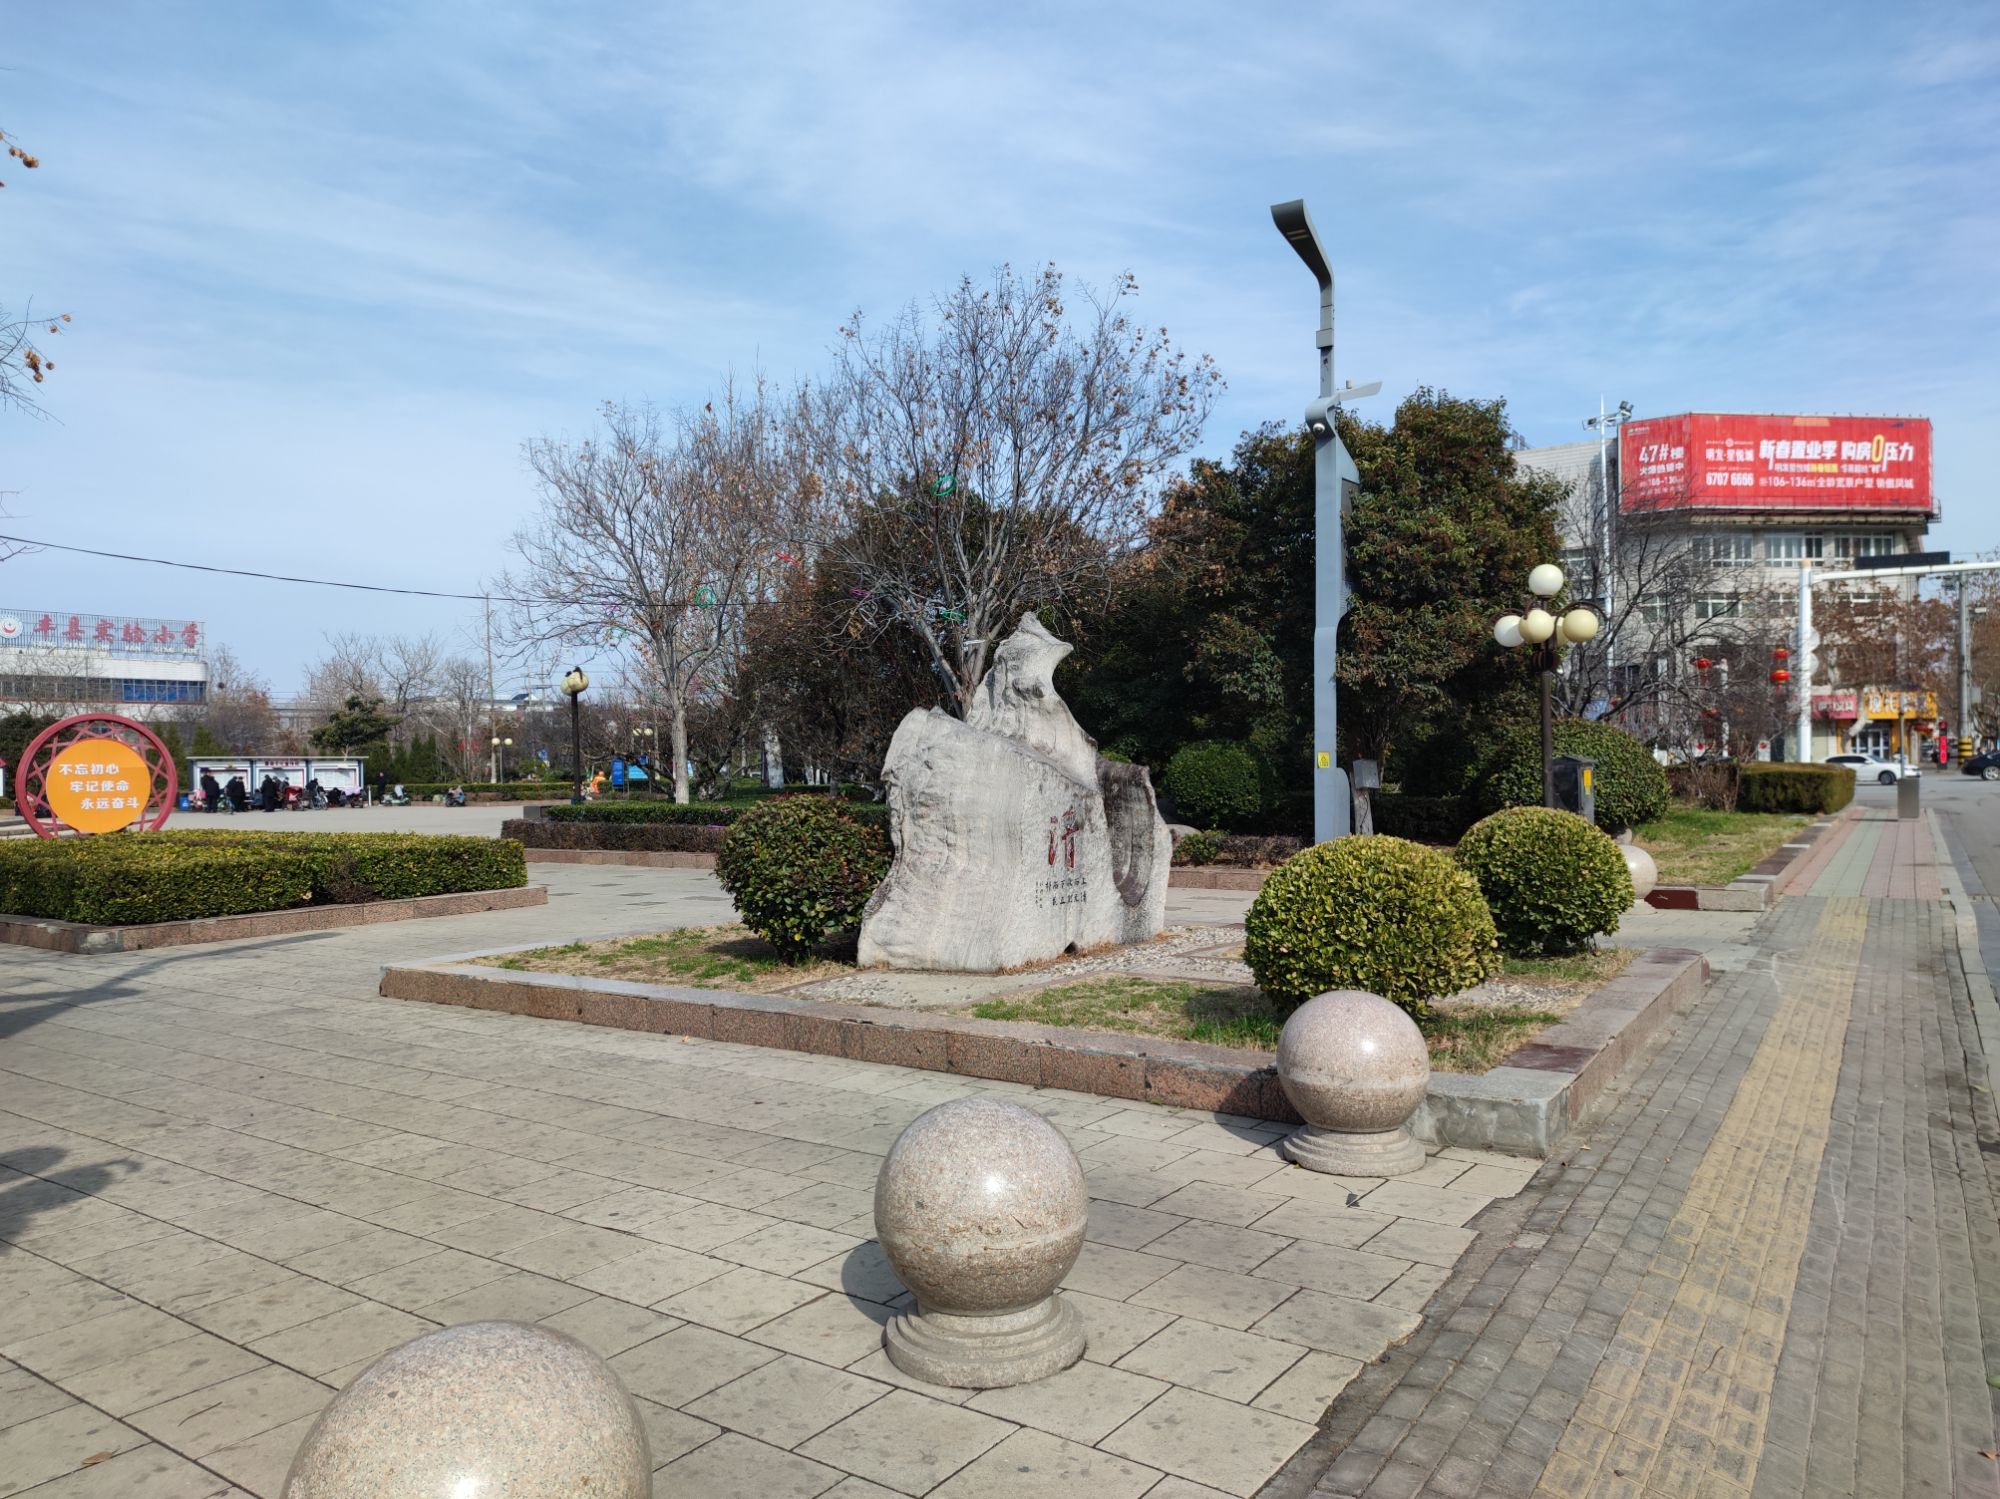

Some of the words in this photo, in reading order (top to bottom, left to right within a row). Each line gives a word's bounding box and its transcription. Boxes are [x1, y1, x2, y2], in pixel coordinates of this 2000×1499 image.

[1759, 439, 1838, 471] 新春置业季
[1841, 434, 1914, 472] 购房0压力
[59, 763, 119, 775] 不忘初心
[70, 780, 130, 792] 牢记使命
[81, 797, 139, 809] 永远奋斗
